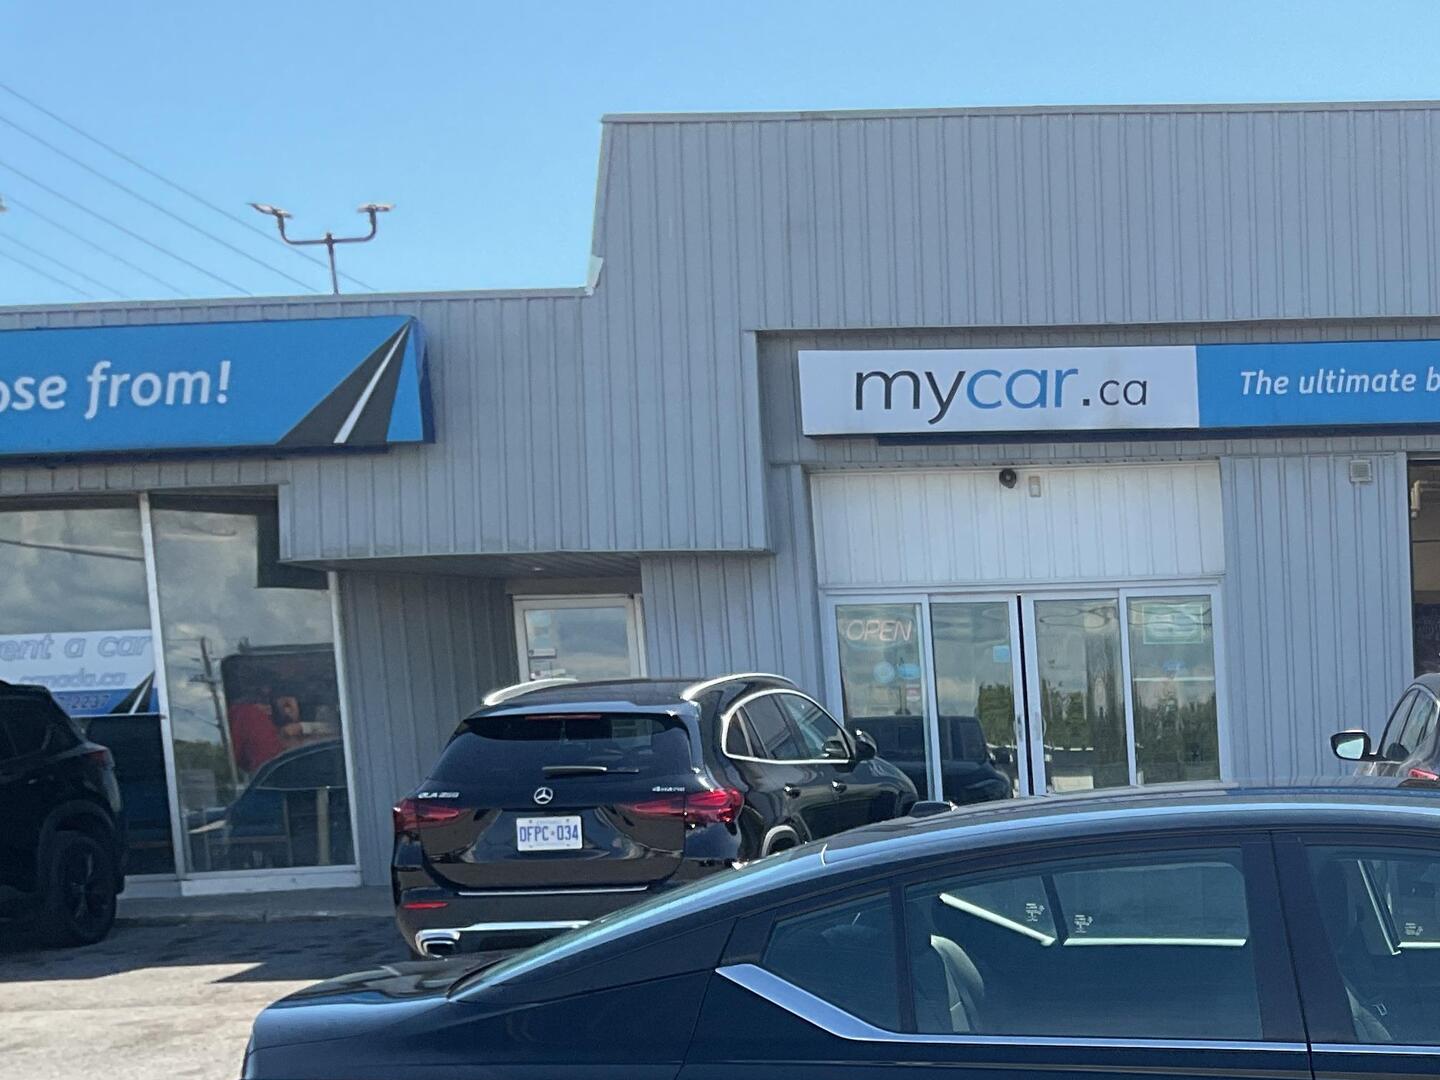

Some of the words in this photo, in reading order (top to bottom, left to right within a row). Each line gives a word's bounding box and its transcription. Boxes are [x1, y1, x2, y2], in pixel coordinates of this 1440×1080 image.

[84, 360, 231, 420] from!
[1241, 369, 1289, 395] The
[1299, 368, 1416, 394] ultimate
[856, 369, 1147, 425] mycar.ca
[847, 619, 912, 641] OPEN
[64, 637, 86, 658] a
[97, 635, 152, 657] car
